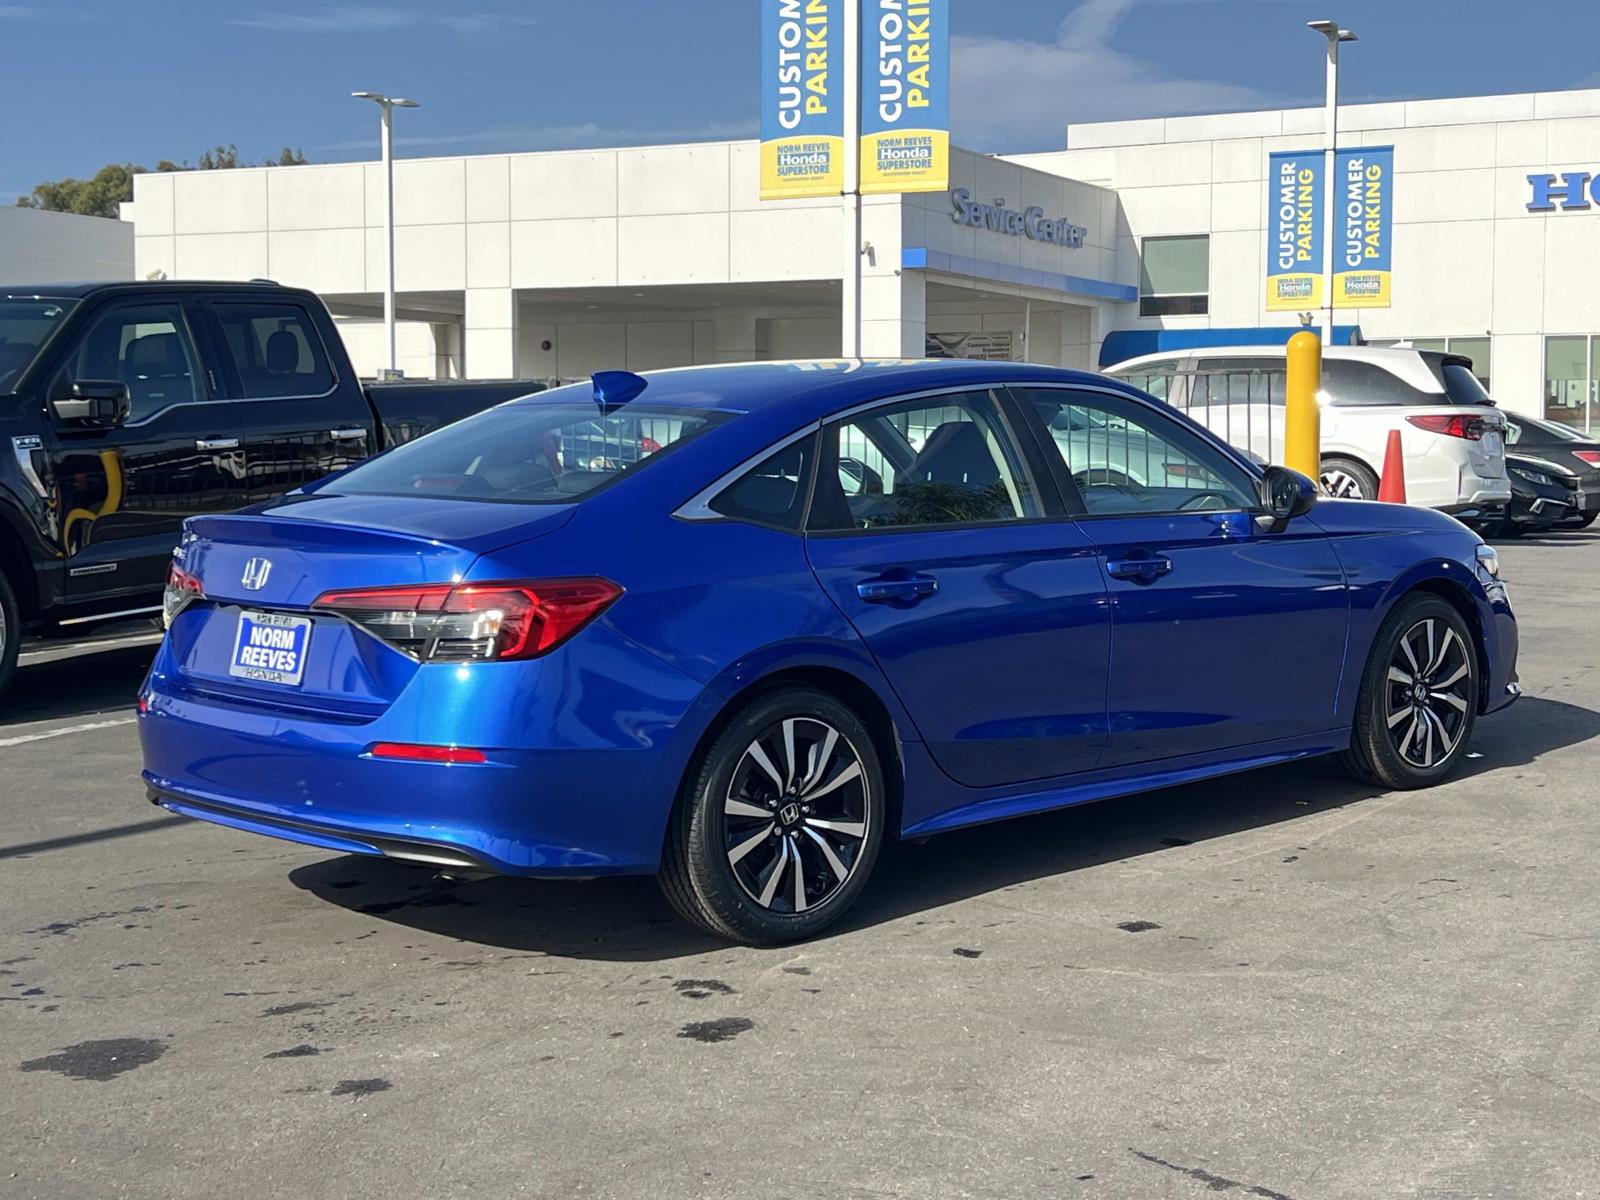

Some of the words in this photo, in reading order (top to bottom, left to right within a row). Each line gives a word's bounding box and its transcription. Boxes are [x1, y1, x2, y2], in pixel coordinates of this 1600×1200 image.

[907, 0, 930, 108] PARKI
[877, 137, 902, 147] NORM
[904, 136, 932, 146] REEVES
[880, 147, 929, 160] Honda
[777, 164, 830, 176] SUPERSTORE
[780, 153, 827, 166] Honda
[877, 159, 932, 171] SUPERSTORE
[1525, 172, 1600, 213] H
[952, 187, 1025, 237] Service
[1024, 205, 1088, 249] Center
[1279, 162, 1296, 270] CUSTOMER
[1297, 169, 1314, 261] PARKING
[1346, 158, 1364, 267] CUSTOMER
[1364, 164, 1382, 259] PARKING
[249, 626, 296, 650] NORM
[240, 646, 297, 671] REEVES
